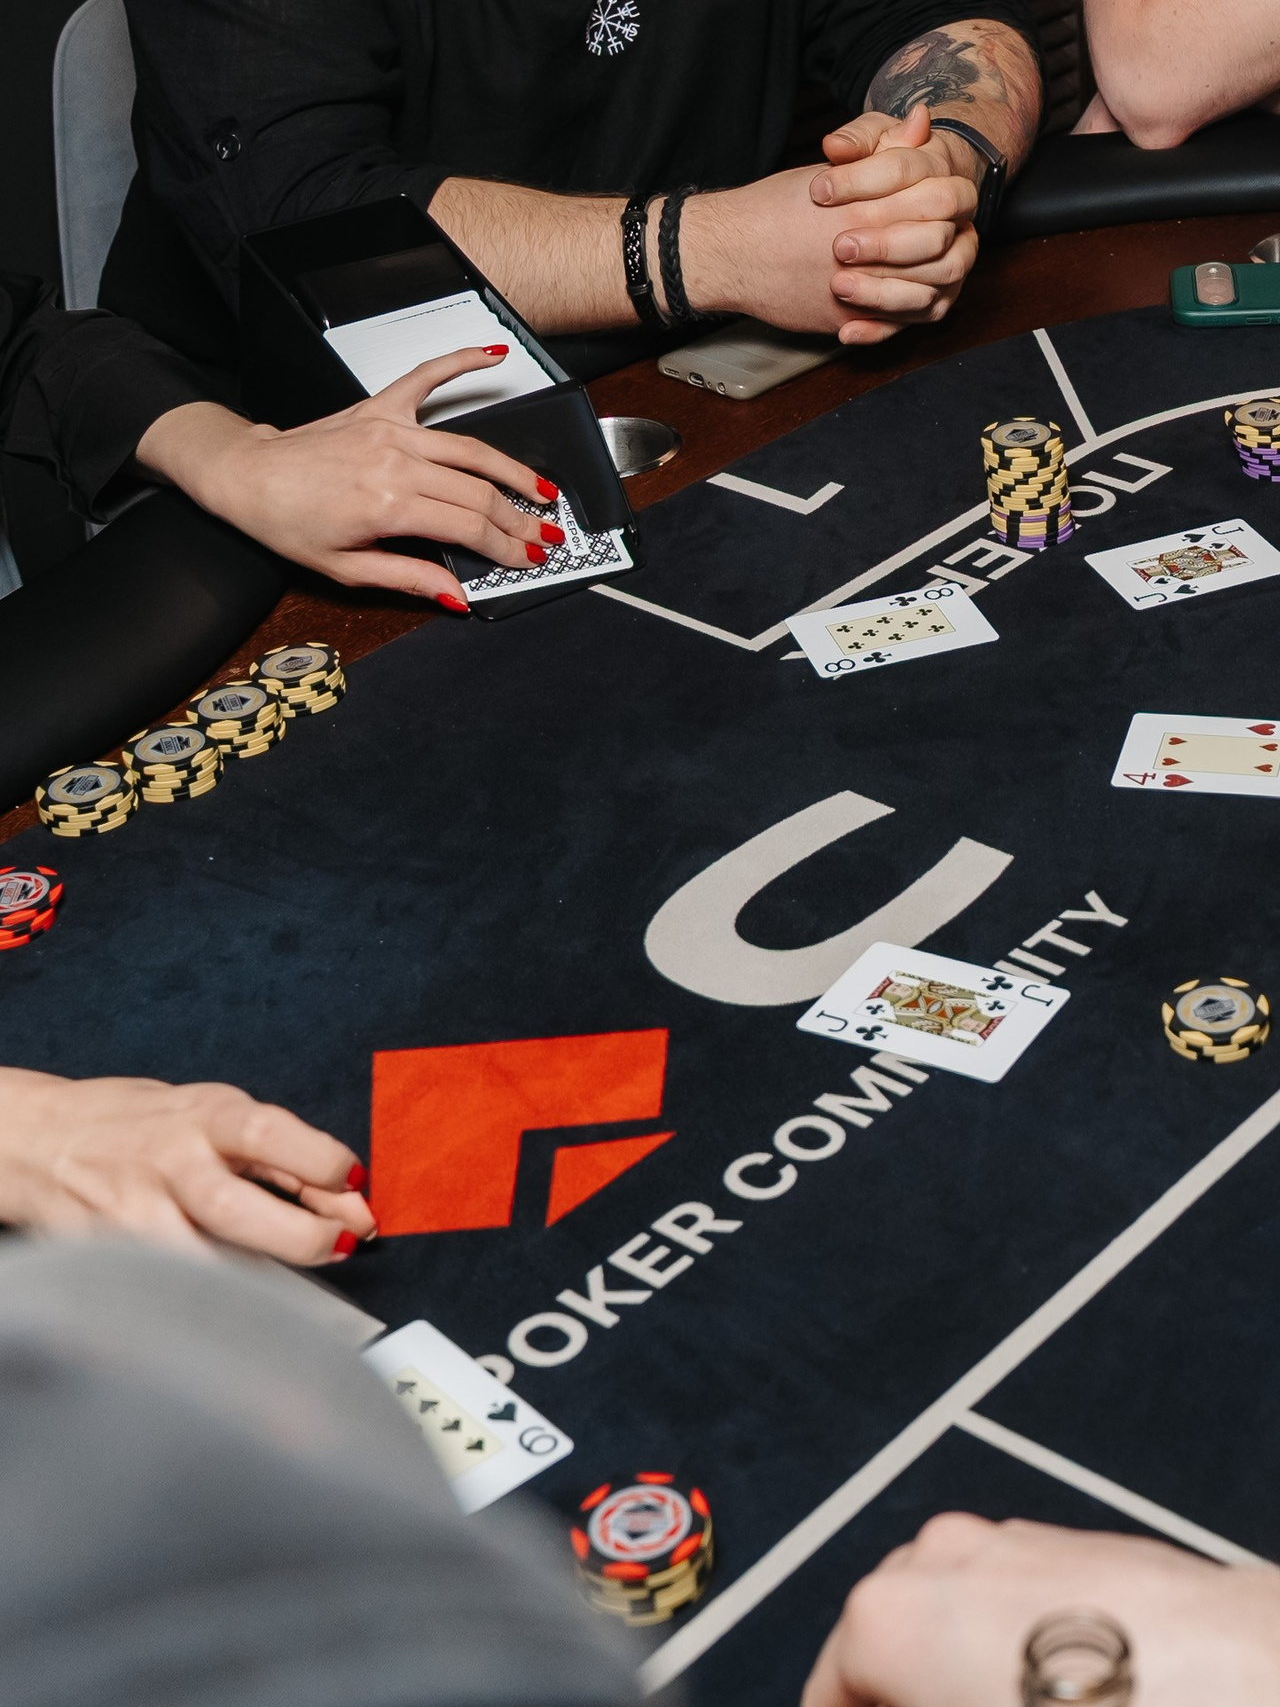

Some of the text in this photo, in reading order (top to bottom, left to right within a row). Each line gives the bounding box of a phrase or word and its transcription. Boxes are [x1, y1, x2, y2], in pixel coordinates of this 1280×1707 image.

[1211, 525, 1245, 536] J
[923, 587, 954, 600] 8
[1133, 592, 1168, 603] J
[824, 658, 856, 673] 8
[1122, 772, 1157, 786] 4
[1020, 984, 1054, 1008] J
[815, 1010, 848, 1033] J
[723, 889, 1129, 1201] COMITY
